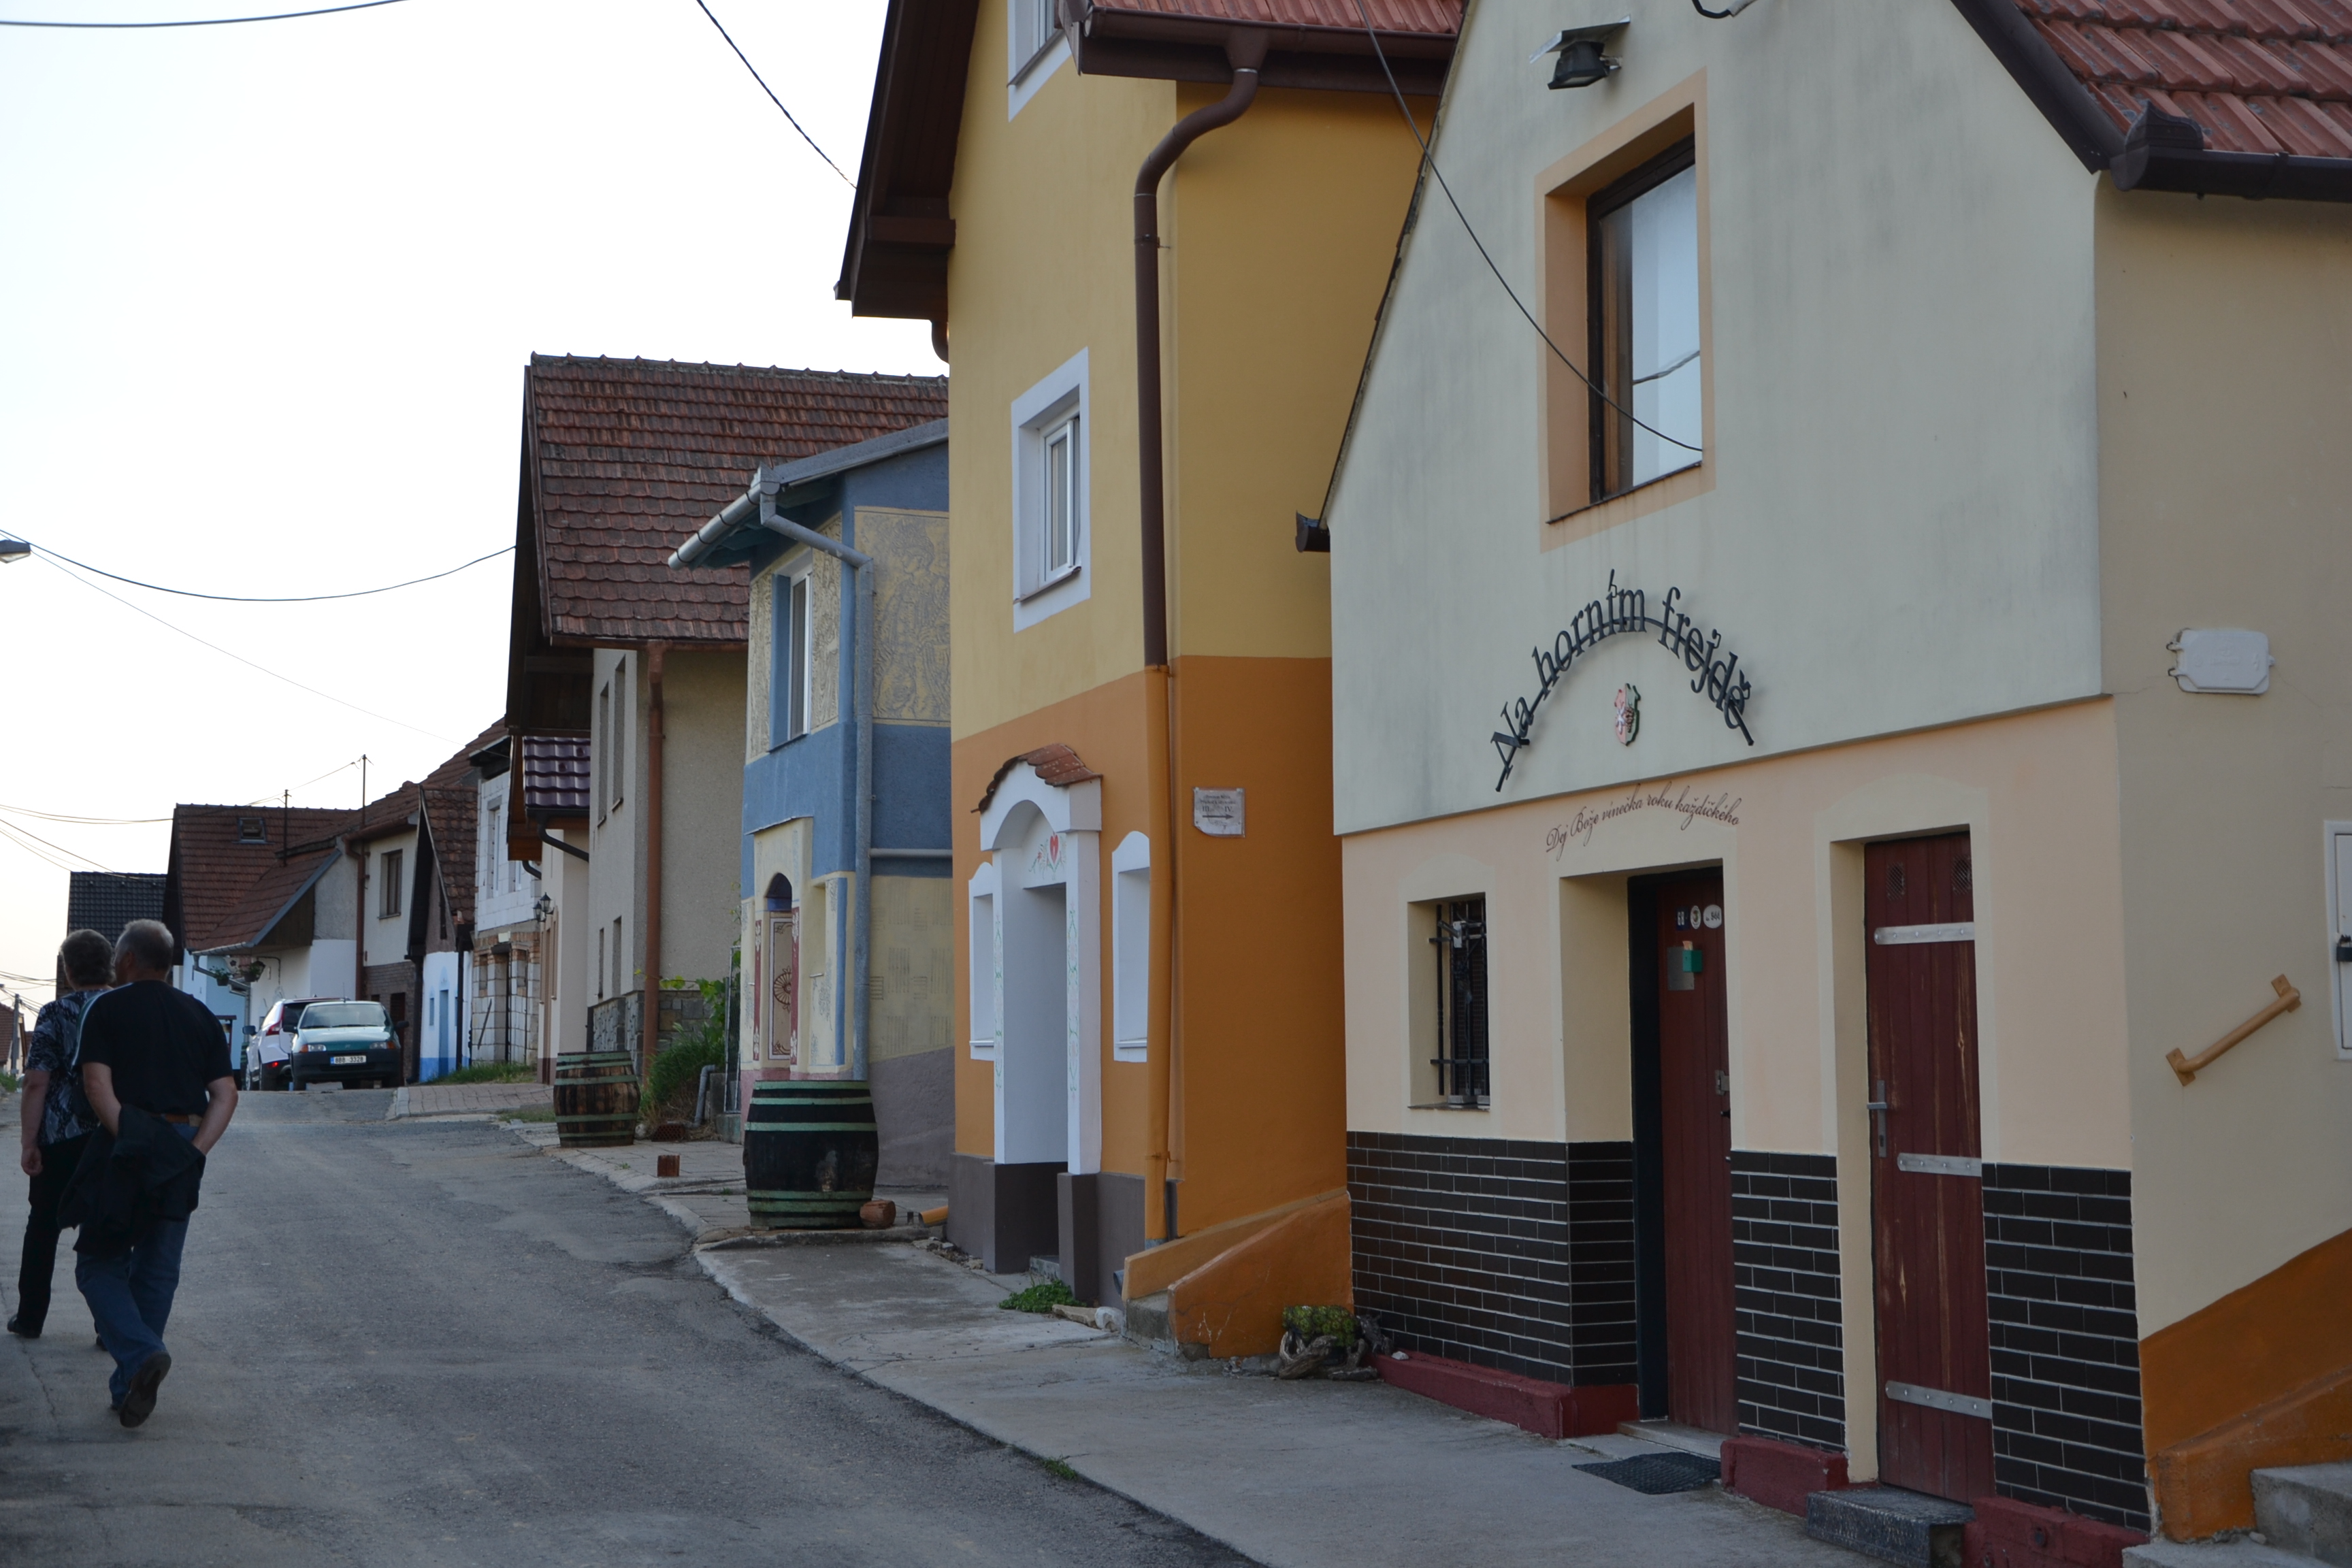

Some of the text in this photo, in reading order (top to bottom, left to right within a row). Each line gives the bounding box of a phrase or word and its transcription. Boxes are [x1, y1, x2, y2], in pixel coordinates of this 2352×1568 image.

[1490, 569, 1752, 780] Na horním frejdě
[1546, 781, 1742, 862] Dej Bože vínečka roku každičkého
